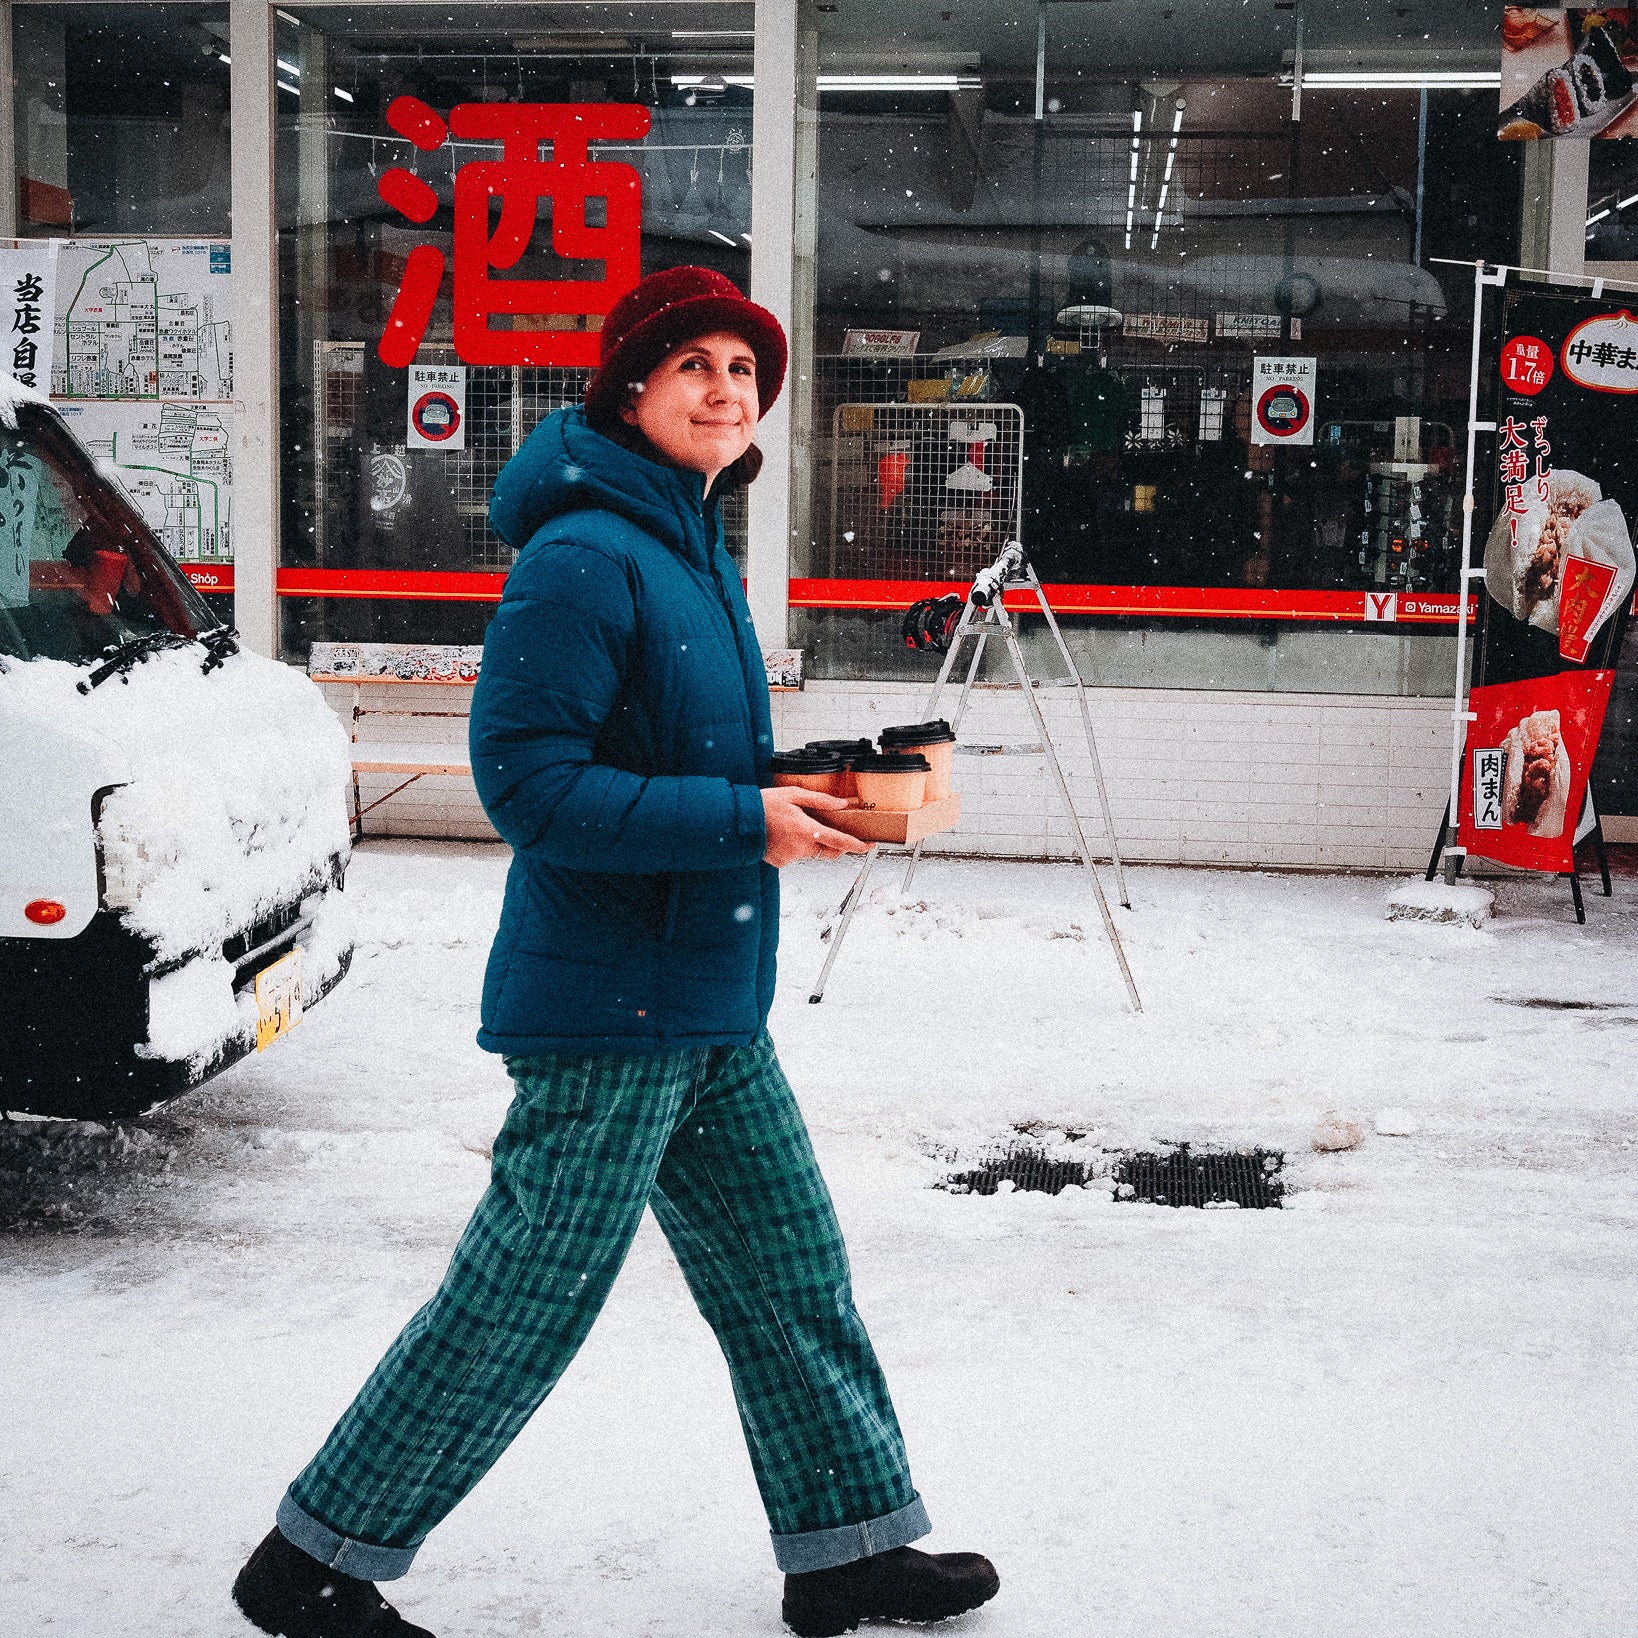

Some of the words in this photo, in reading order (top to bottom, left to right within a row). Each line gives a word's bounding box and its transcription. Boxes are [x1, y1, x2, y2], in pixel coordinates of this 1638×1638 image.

[377, 95, 651, 369] 酒
[1259, 362, 1310, 375] 駐車禁止
[1569, 339, 1638, 371] 中華ま
[414, 370, 460, 383] 駐車禁止
[1507, 357, 1546, 385] 1.7倍
[1530, 415, 1551, 504] ずっしり
[190, 573, 218, 586] Shop
[1369, 594, 1393, 620] Y
[1480, 753, 1499, 823] 肉まん
